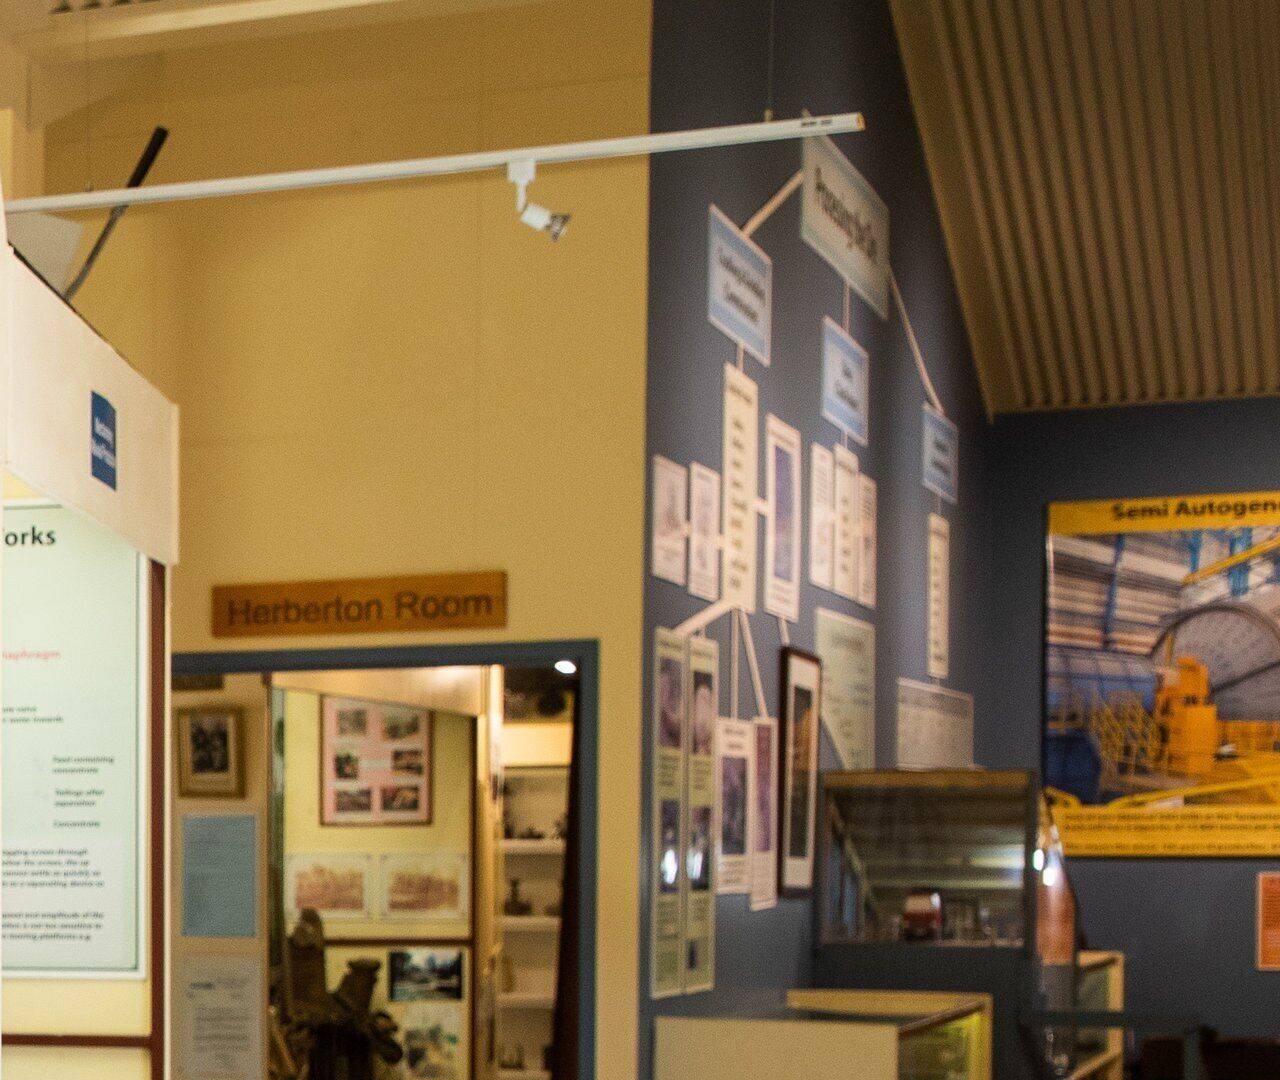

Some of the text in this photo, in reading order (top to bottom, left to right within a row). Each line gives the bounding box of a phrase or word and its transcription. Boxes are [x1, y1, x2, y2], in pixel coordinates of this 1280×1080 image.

[1111, 498, 1280, 520] Semi Autogen
[4, 525, 56, 546] orks
[228, 591, 493, 626] Herberton Room
